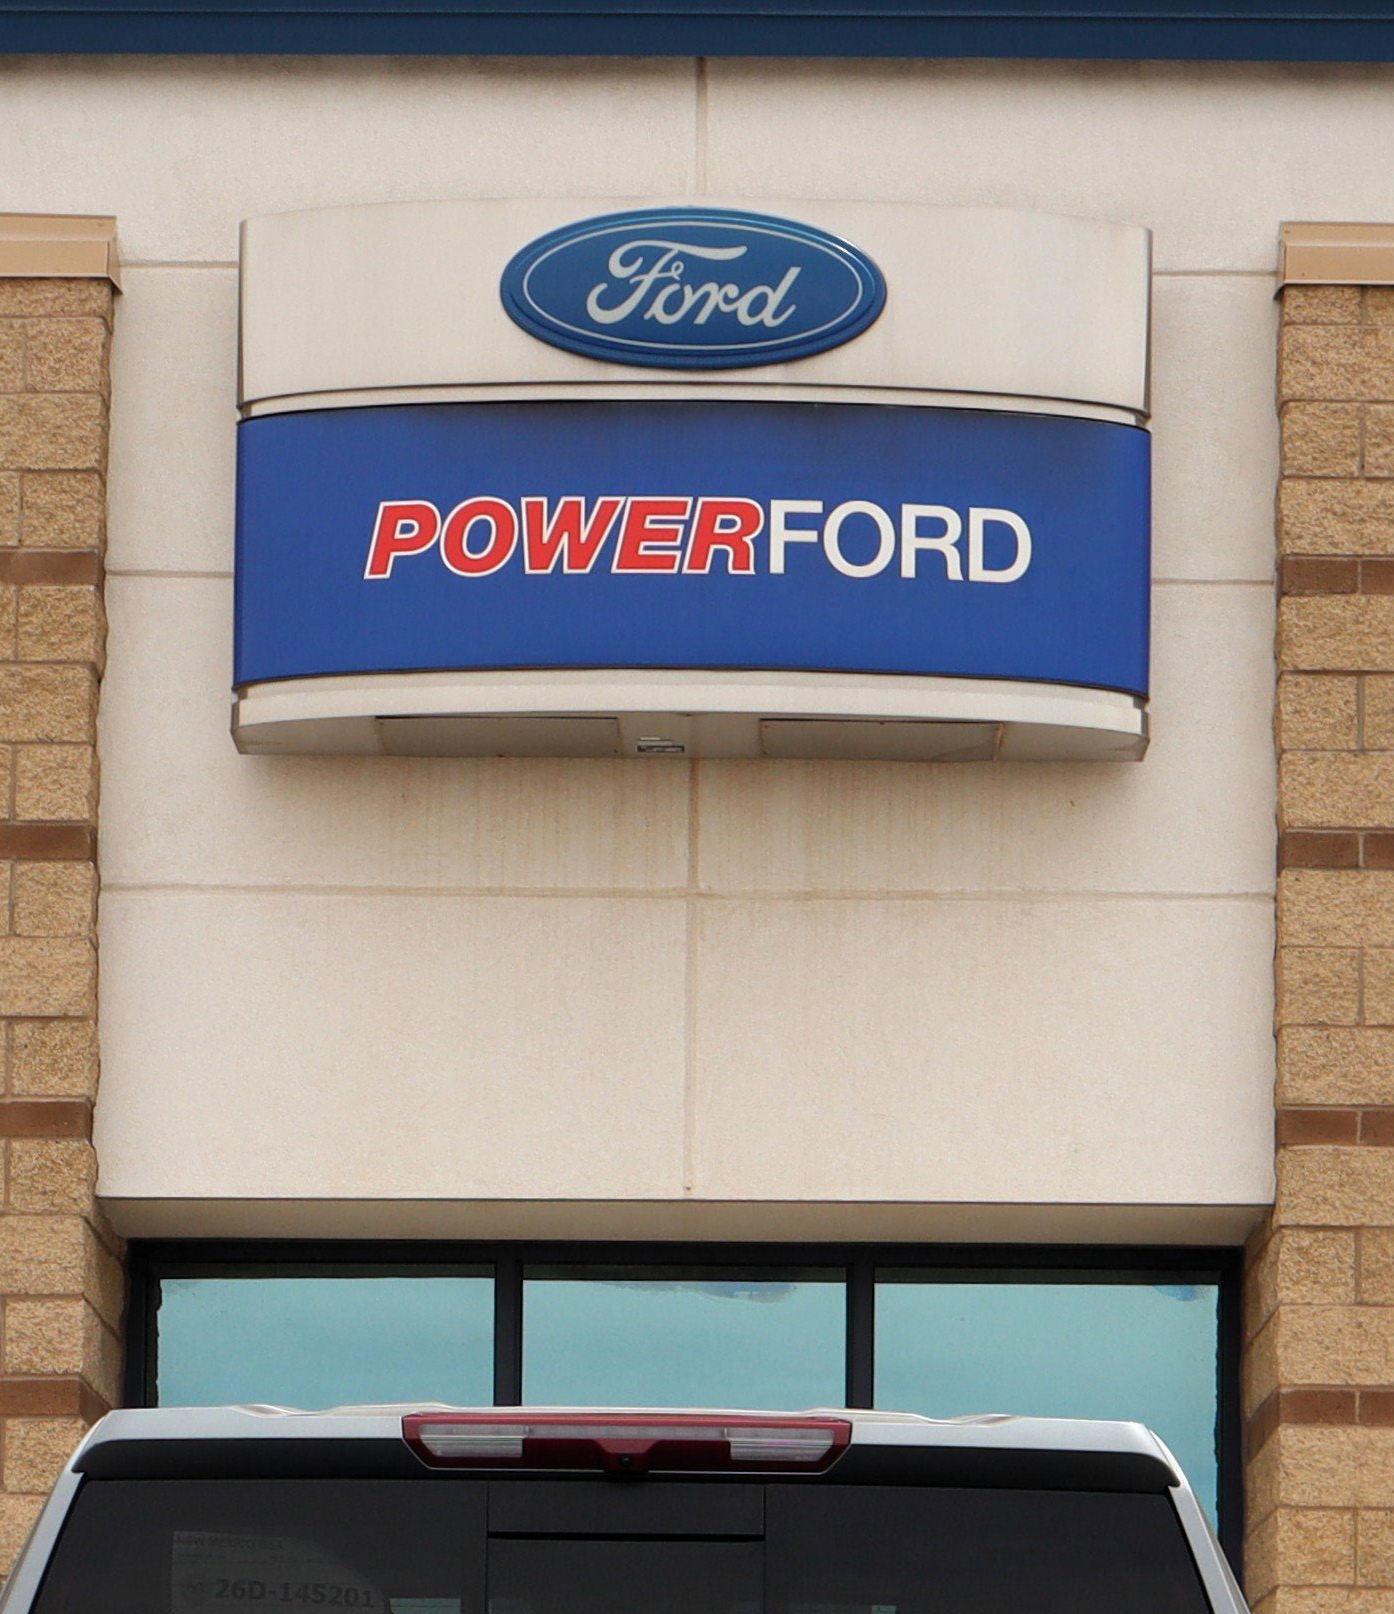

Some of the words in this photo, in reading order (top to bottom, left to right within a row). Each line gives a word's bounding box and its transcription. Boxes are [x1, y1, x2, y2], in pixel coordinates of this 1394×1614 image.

[586, 239, 802, 329] Ford
[363, 495, 1033, 583] POWERFORD
[215, 1578, 375, 1608] 26D-145201
